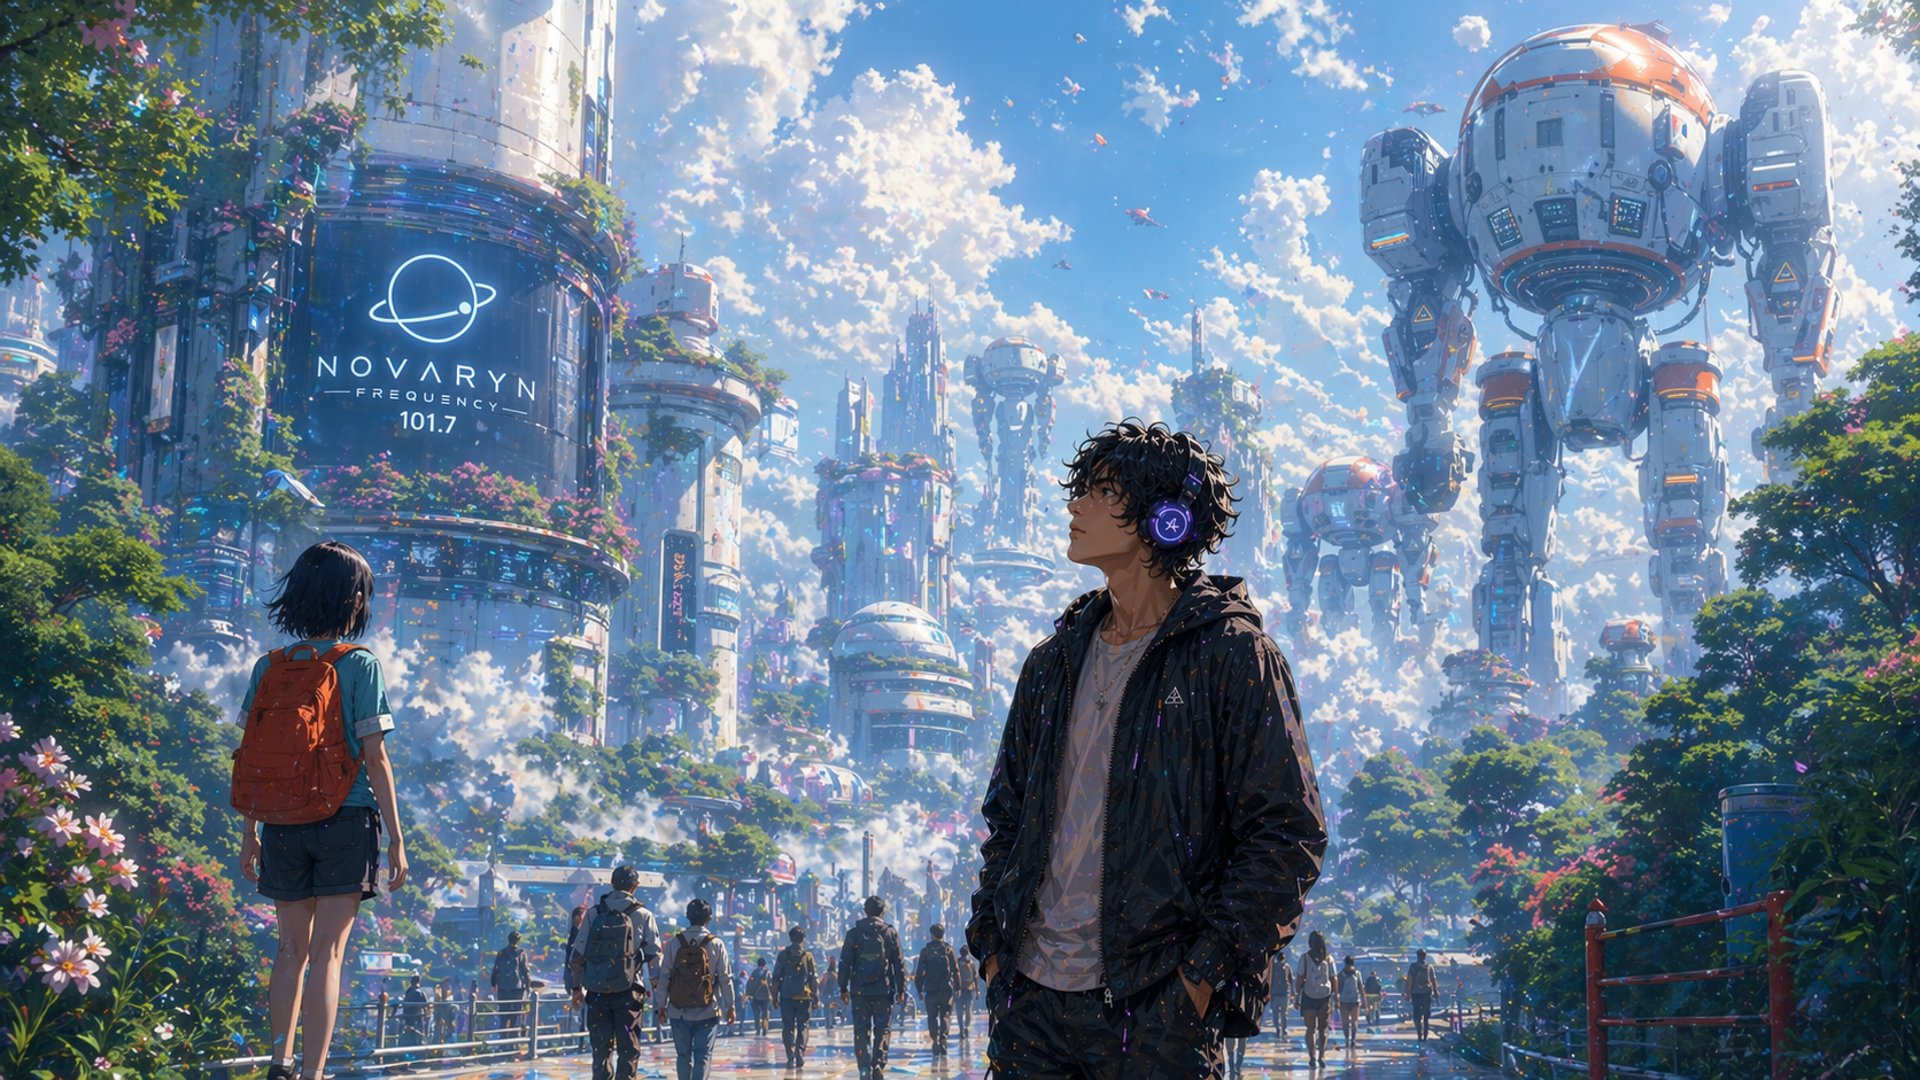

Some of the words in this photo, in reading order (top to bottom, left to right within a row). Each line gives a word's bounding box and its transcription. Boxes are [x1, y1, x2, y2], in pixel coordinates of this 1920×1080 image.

[316, 356, 536, 401] NOVARYN
[356, 388, 498, 412] FREQUENCY
[400, 411, 457, 434] 101.7
